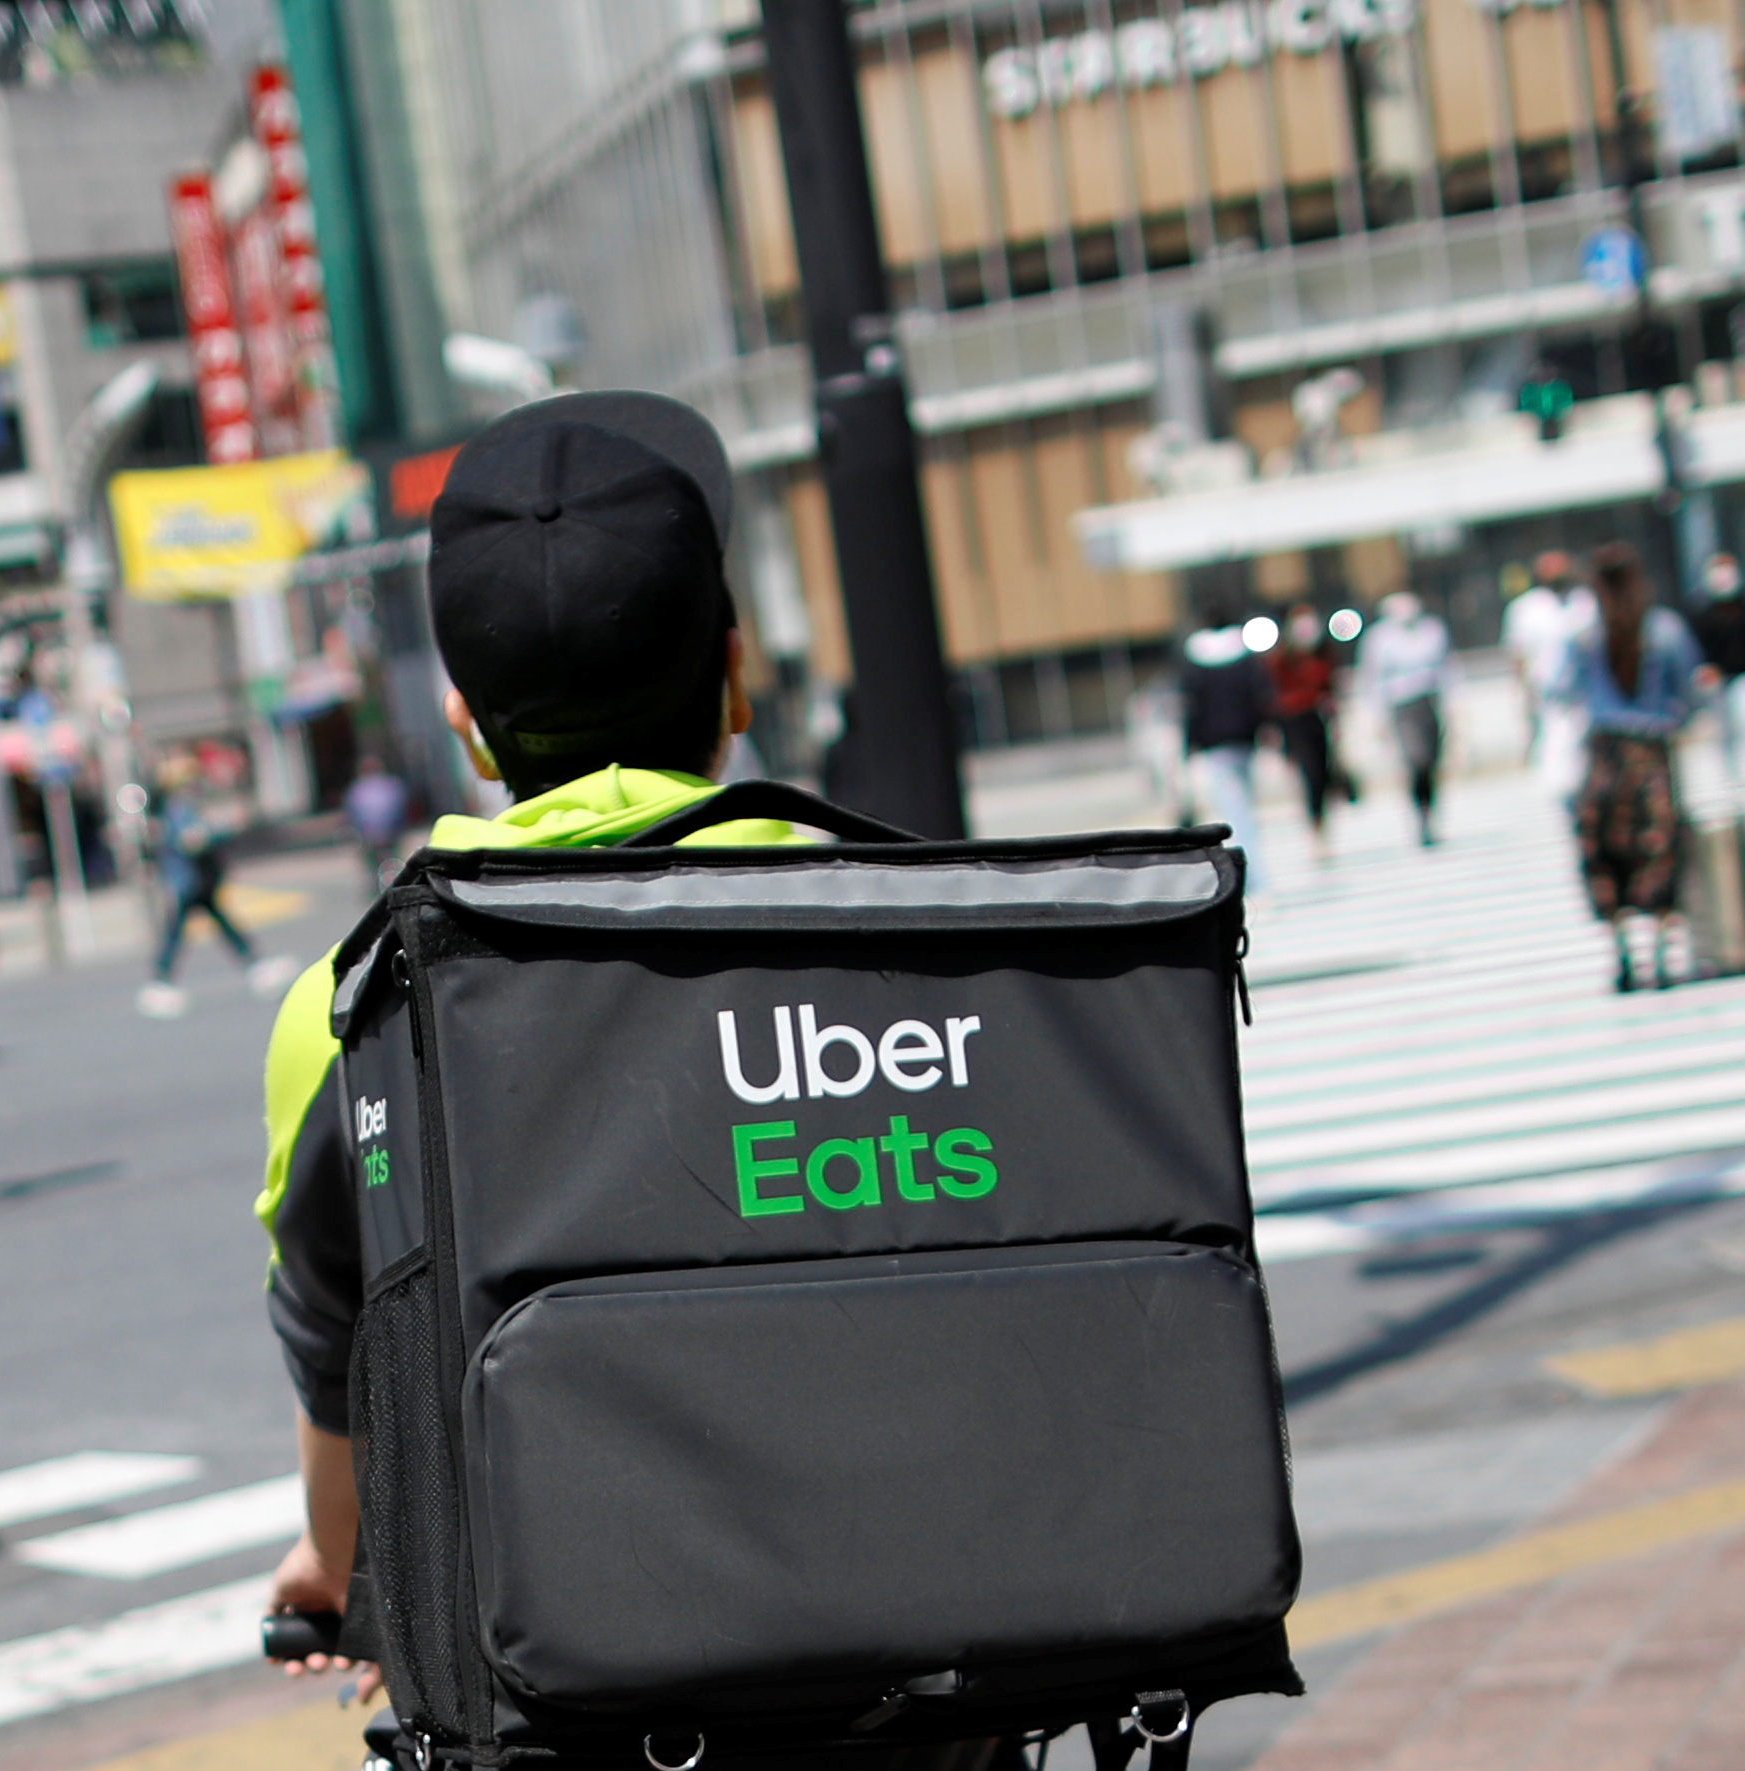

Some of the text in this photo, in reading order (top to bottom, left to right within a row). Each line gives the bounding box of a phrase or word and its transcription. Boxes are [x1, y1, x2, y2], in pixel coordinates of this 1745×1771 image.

[717, 1003, 982, 1105] Uber
[356, 1095, 387, 1142] Uber
[731, 1115, 999, 1217] Eats
